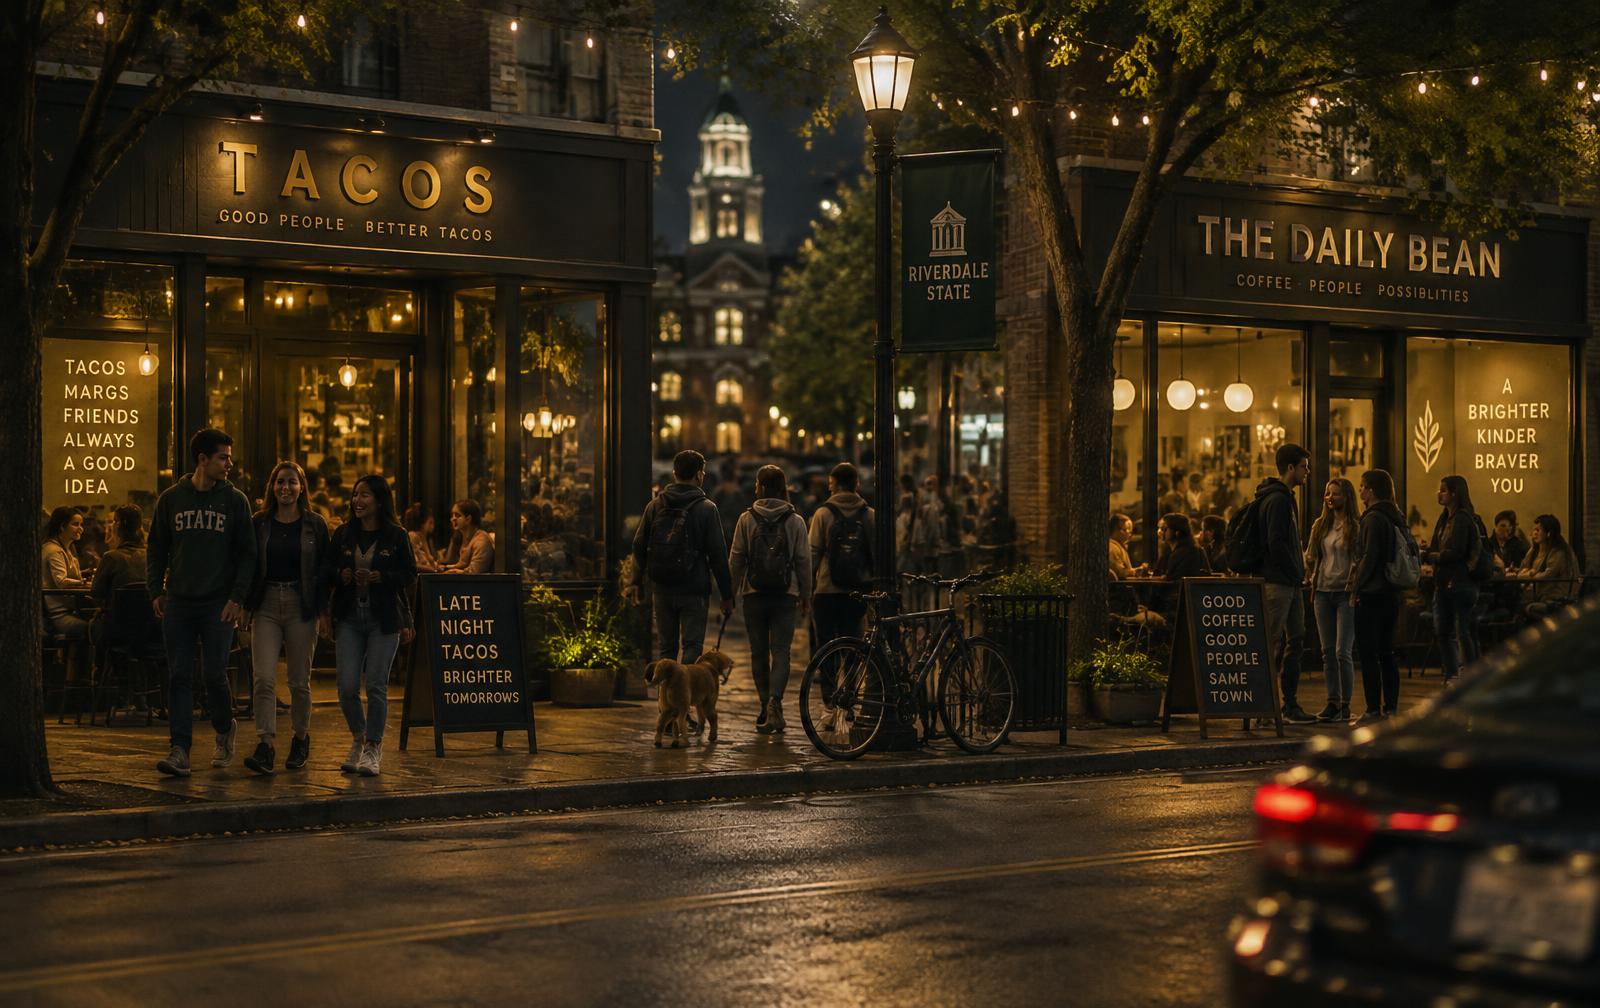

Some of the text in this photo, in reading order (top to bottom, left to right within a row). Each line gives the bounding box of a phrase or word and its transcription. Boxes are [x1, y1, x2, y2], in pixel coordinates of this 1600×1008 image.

[219, 141, 493, 214] TACOS
[219, 209, 493, 242] GOOD PEOPLE BETTER TACOS
[1198, 215, 1501, 279] THE DAILY BEAN
[908, 262, 989, 282] RIVERDALE
[1237, 273, 1292, 289] COFFEE
[1309, 279, 1361, 295] PEOPLE
[927, 284, 971, 301] STATE
[65, 359, 126, 376] TACOS
[64, 384, 129, 401] MARGS
[1502, 377, 1512, 395] A
[64, 408, 139, 425] FRIENDS
[1468, 403, 1550, 420] BRIGHTER
[63, 432, 135, 448] ALWAYS
[1477, 428, 1537, 444] KINDER
[63, 455, 135, 471] A GOOD
[1475, 453, 1539, 469] BRAVER
[64, 479, 109, 494] IDEA
[1491, 478, 1524, 493] YOU
[175, 510, 227, 533] STATE
[439, 595, 482, 611] LATE
[1202, 595, 1245, 608] GOOD
[440, 619, 495, 635] NIGHT
[1202, 614, 1255, 627] COFFEE
[1205, 633, 1248, 646] GOOD
[441, 644, 499, 660] TACOS
[1206, 652, 1259, 665] PEOPLE
[443, 670, 513, 684] BRIGHTER
[1209, 672, 1248, 685] SAME
[444, 691, 520, 704] TOMORROWS
[1210, 690, 1254, 703] TOWN
